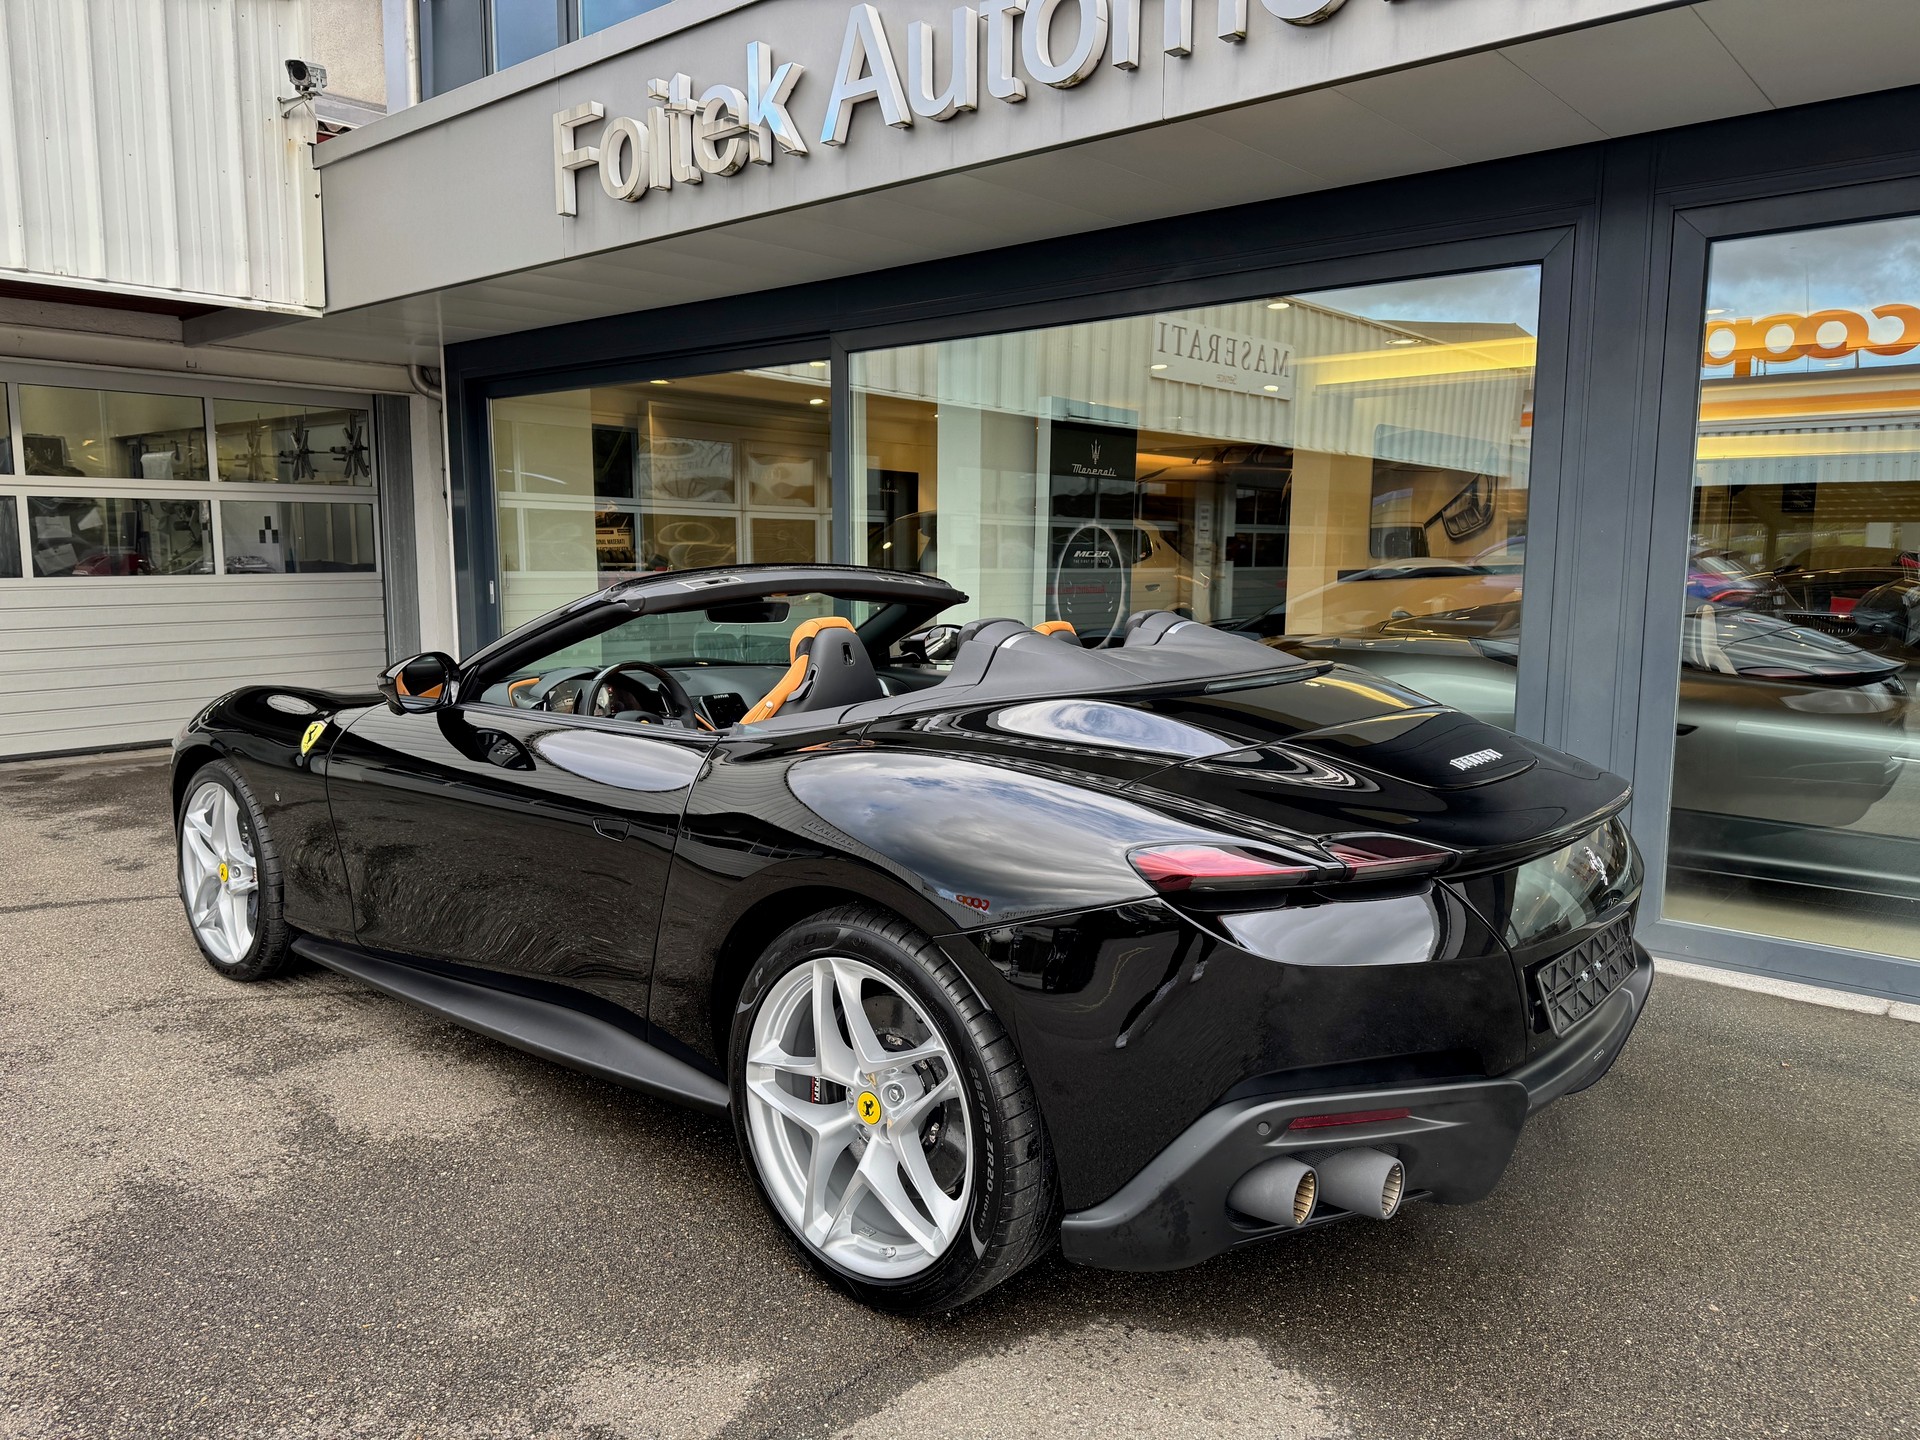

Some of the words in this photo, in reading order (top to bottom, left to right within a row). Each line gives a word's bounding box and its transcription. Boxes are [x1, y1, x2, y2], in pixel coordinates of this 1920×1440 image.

[553, 40, 809, 217] Foitek
[1072, 463, 1117, 477] Maserati
[969, 1066, 993, 1136] 285/35
[986, 1137, 995, 1192] ZR20
